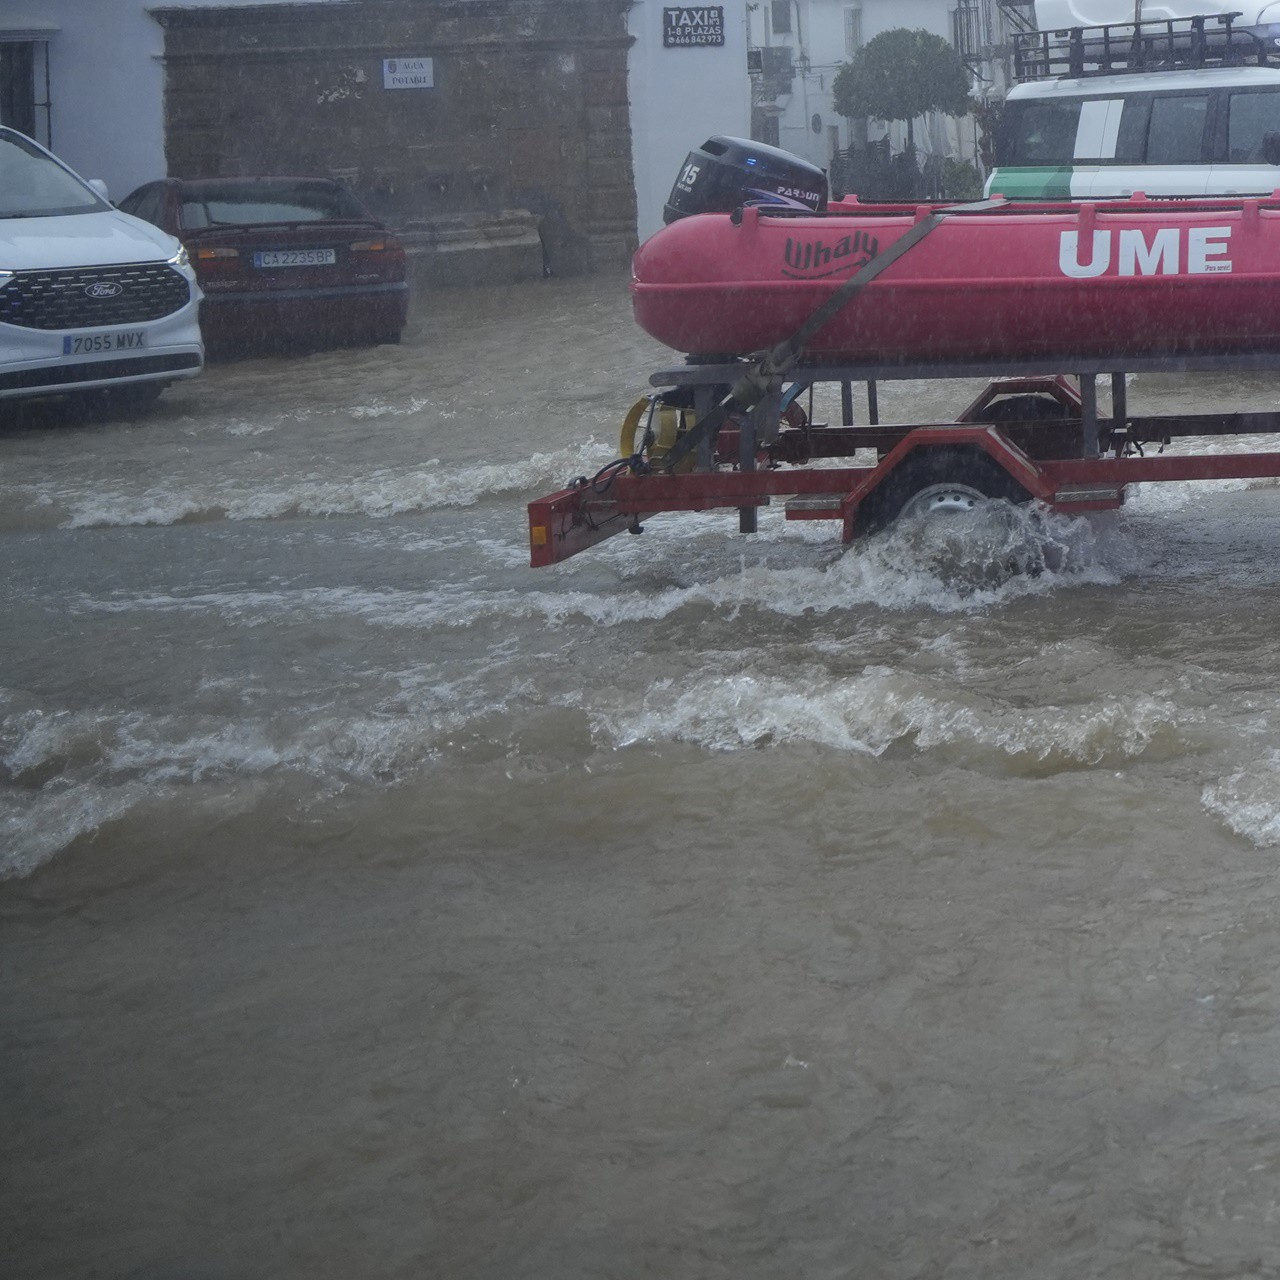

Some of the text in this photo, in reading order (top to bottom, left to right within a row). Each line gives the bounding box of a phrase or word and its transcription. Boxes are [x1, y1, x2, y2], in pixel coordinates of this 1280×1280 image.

[667, 10, 708, 26] TAXI
[667, 26, 721, 36] 1-8 PLAZAS
[682, 163, 701, 185] 15
[281, 250, 315, 265] 2235
[316, 250, 333, 263] BP
[784, 230, 879, 271] Whaly
[1059, 226, 1231, 278] UME
[91, 284, 117, 296] Ford
[74, 332, 144, 355] 7055 MVX
